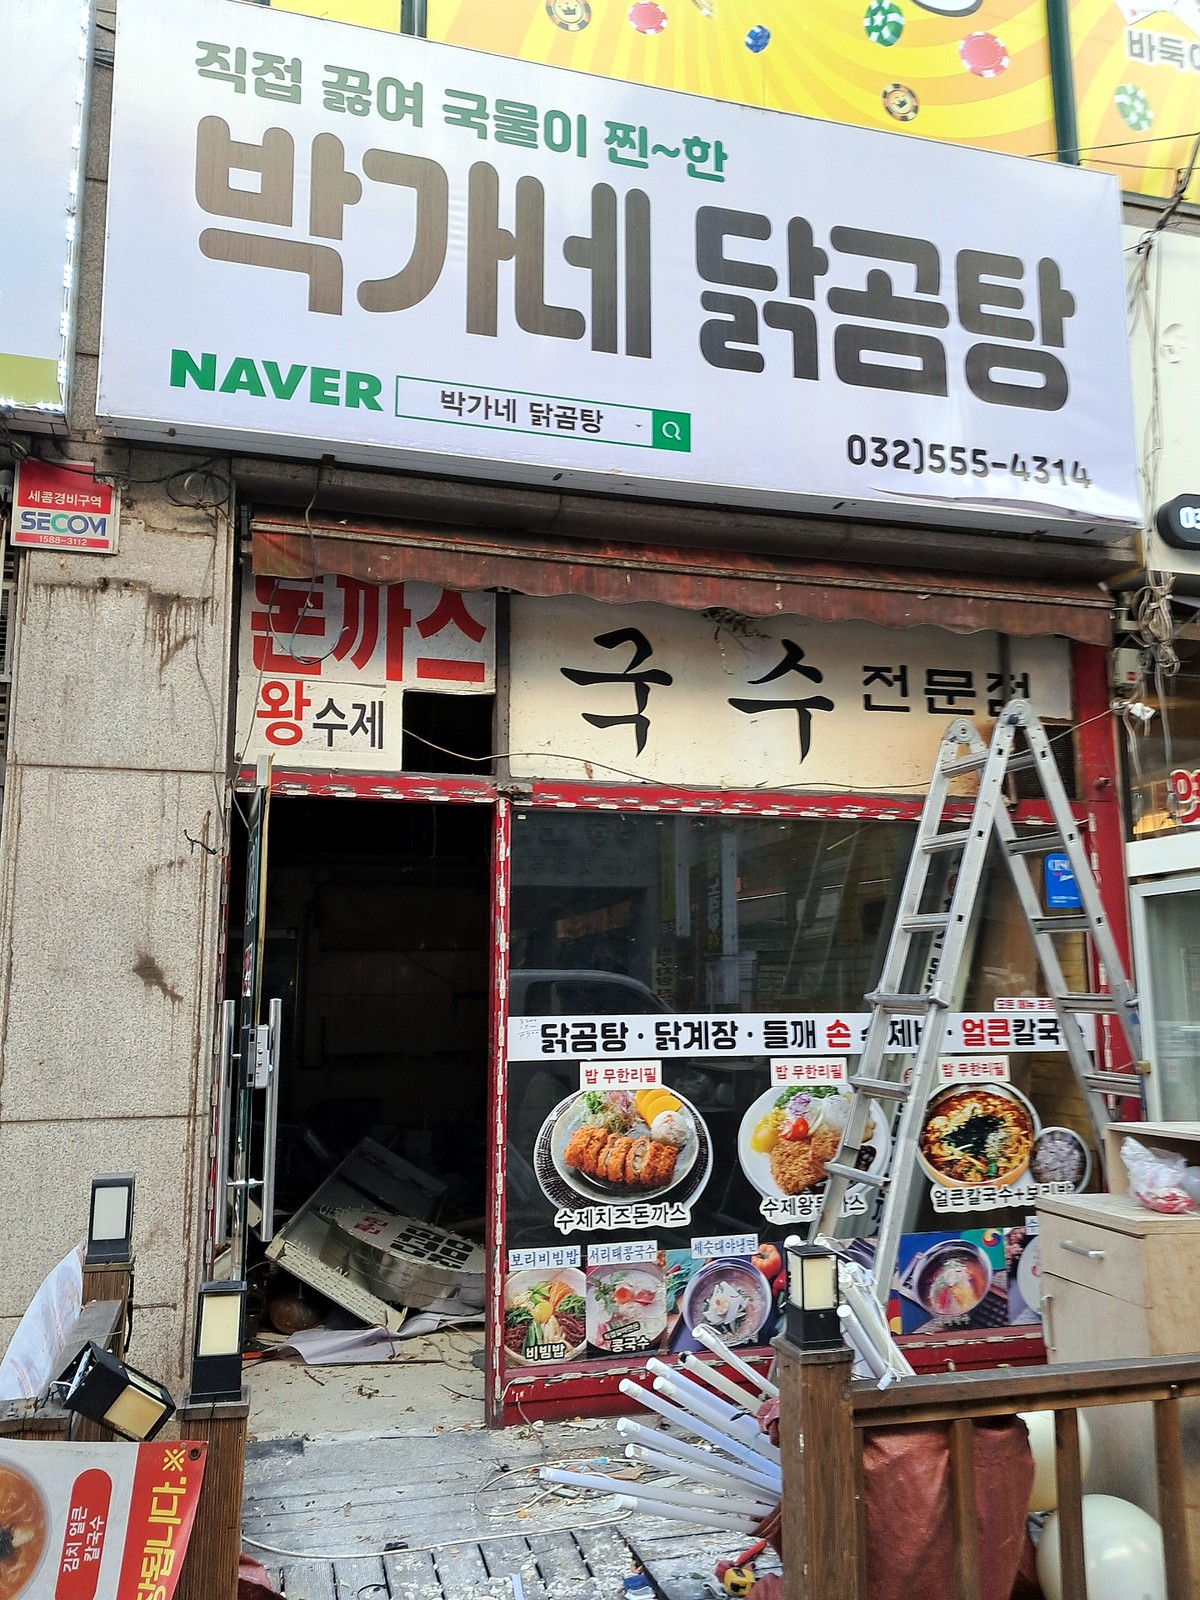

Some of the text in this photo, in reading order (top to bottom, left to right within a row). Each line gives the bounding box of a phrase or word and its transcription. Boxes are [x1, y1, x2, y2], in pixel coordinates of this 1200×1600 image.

[195, 40, 728, 183] 직접 끓여 국물이 찐~한
[195, 115, 1077, 412] 박가네 닭곰탕
[170, 349, 384, 411] NAVER
[440, 390, 604, 434] 박가네 닭곰탕
[847, 434, 1093, 489] 032)555-4314
[28, 490, 102, 508] 세콤경비구역
[21, 511, 107, 536] SECOM
[39, 536, 88, 546] 1588-3112
[251, 574, 487, 682] 돈까스
[863, 664, 1030, 717] 전문점
[541, 1022, 628, 1053] 닭곰탕
[655, 1020, 738, 1051] 닭계장
[763, 1019, 818, 1049] 들깨
[826, 1019, 851, 1048] 손
[962, 1018, 1084, 1047] 얼큰칼국
[584, 1066, 657, 1084] 밥 무한리필
[775, 1063, 843, 1081] 밥 무한리필
[941, 1060, 1005, 1078] 밥 무한리필
[556, 1203, 687, 1230] 수제치즈돈까스
[762, 1195, 866, 1217] 수제왕스
[510, 1249, 579, 1267] 보리비빔밥
[589, 1244, 657, 1263] 서리태콩국수
[692, 1238, 757, 1255] 세숫대야냉면
[526, 1343, 565, 1360] 비빔밥
[611, 1336, 650, 1353] 콩국수
[62, 1506, 88, 1573] 김치 얼큰
[83, 1515, 105, 1562] 칼국수
